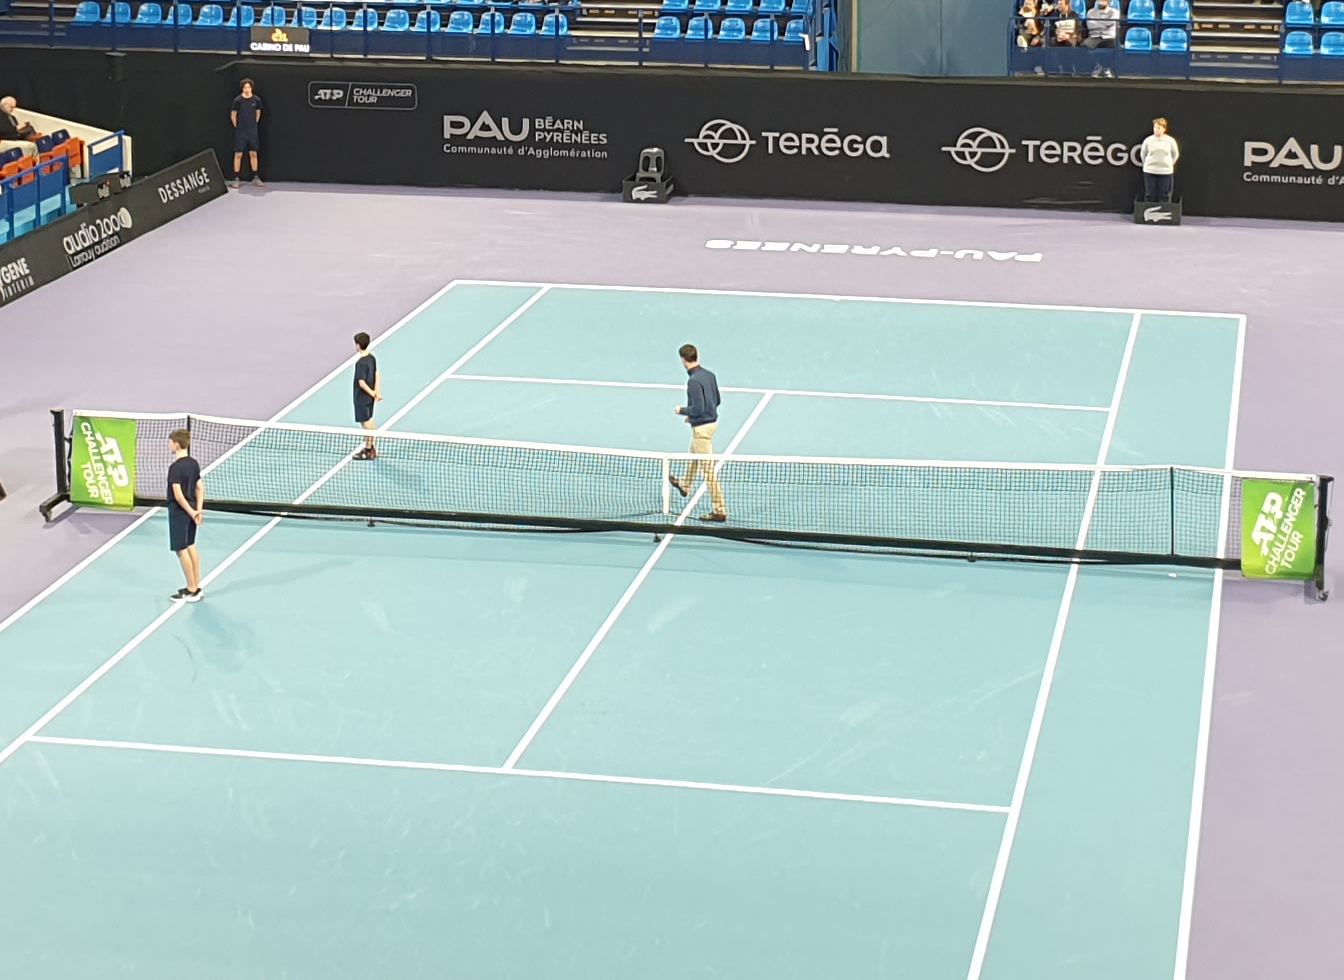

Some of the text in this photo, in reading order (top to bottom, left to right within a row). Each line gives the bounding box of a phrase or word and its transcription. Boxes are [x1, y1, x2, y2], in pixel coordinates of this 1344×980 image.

[314, 89, 344, 100] ATP
[353, 88, 413, 98] CHALLENGER
[353, 95, 378, 104] TOUR
[443, 110, 530, 142] PAU
[443, 143, 608, 159] Communauté d'Agglomération
[1243, 136, 1343, 170] PAU
[157, 167, 211, 204] DESSANGE
[1243, 172, 1323, 186] Communauté
[62, 223, 98, 255] audio
[94, 233, 121, 256] audition
[80, 422, 114, 505] CHALLENGER
[94, 430, 130, 488] ATP
[80, 461, 100, 499] TOUR
[1251, 491, 1284, 557] ATP
[1264, 486, 1307, 576] CHALLENGER
[1280, 530, 1304, 570] TOUR
